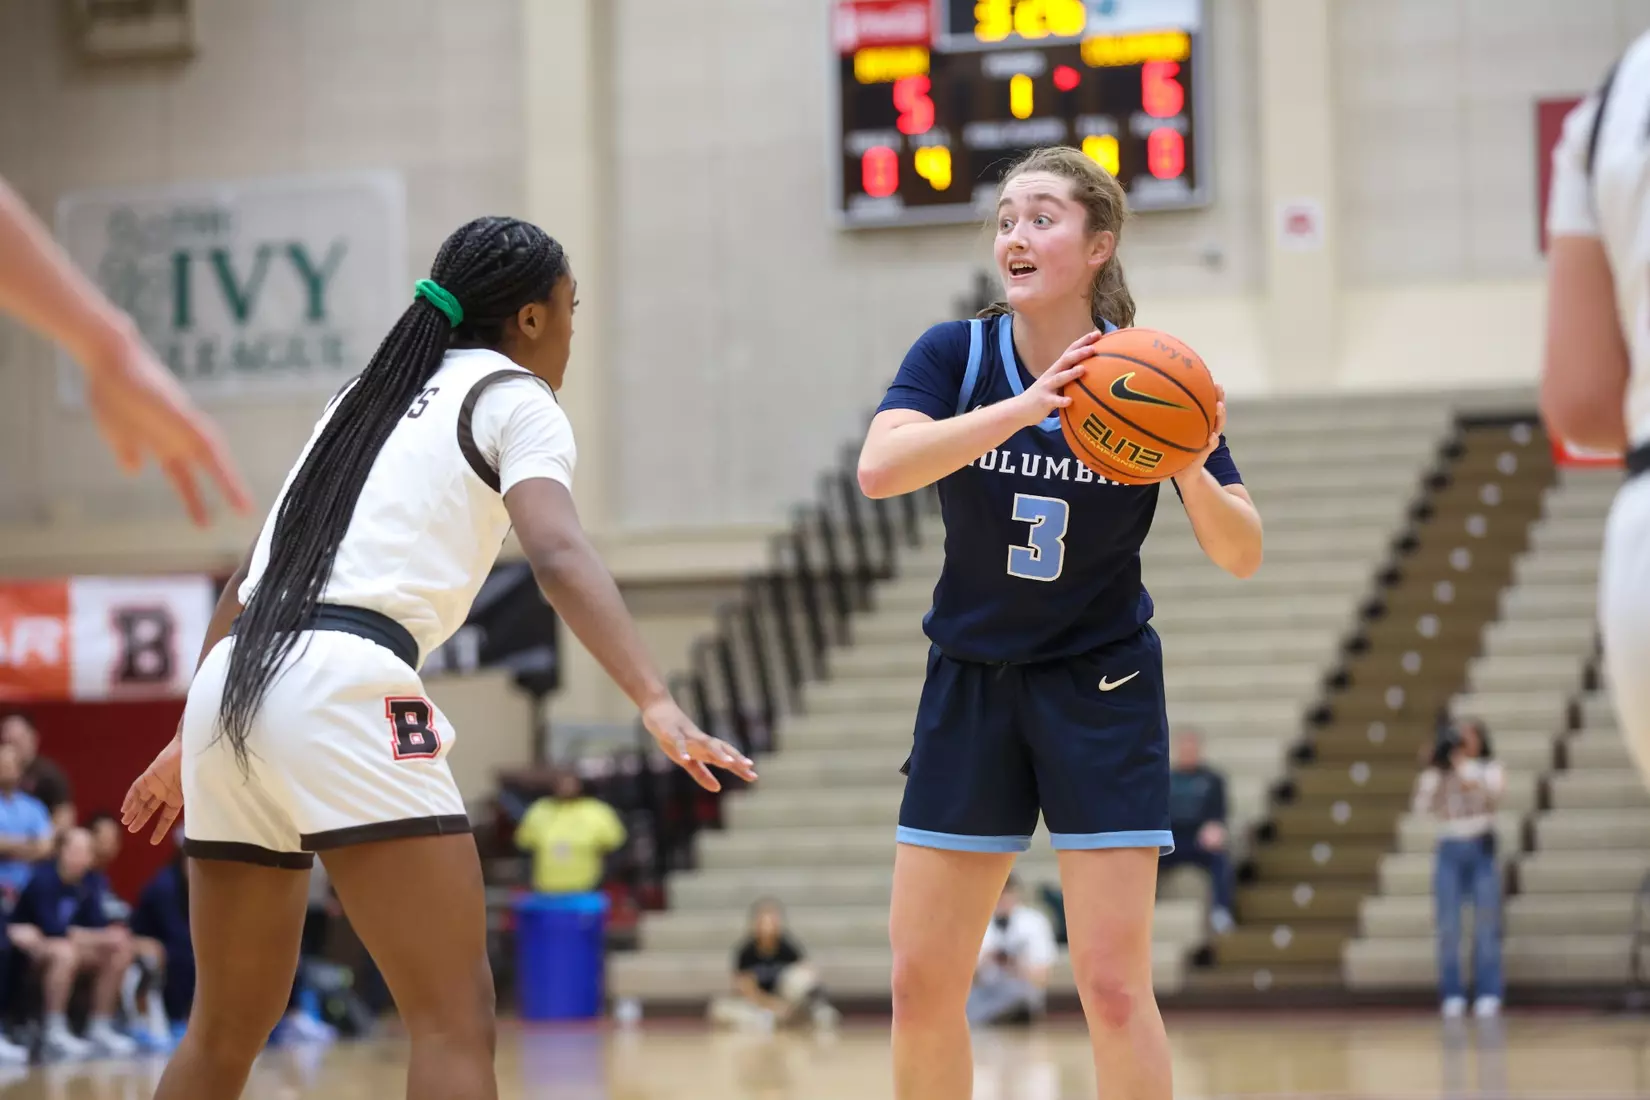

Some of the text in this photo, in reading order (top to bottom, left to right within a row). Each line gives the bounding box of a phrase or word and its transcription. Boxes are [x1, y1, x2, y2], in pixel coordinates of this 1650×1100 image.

[892, 74, 935, 135] 5
[1142, 59, 1184, 118] 6
[172, 240, 347, 332] IVY
[967, 448, 1130, 487] OLUMB
[1082, 412, 1165, 470] ELITE
[1007, 492, 1070, 582] 3
[109, 601, 177, 690] B
[384, 695, 442, 761] B
